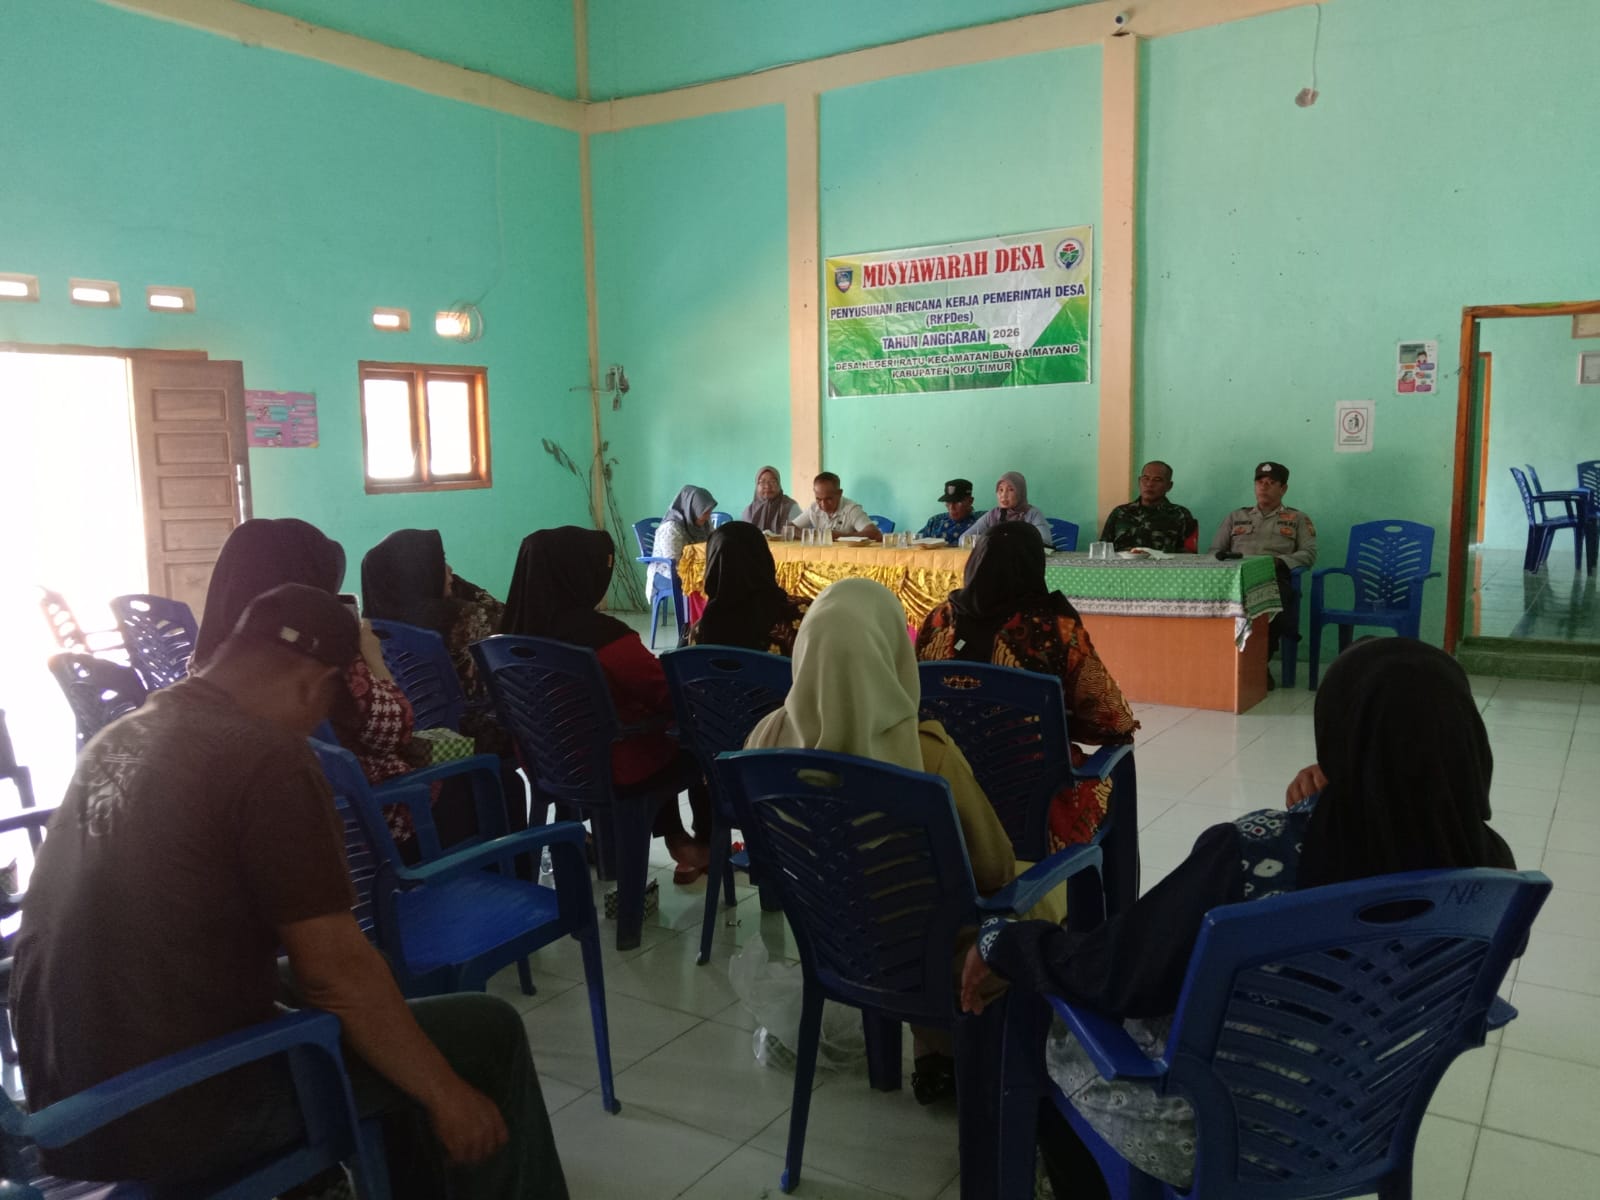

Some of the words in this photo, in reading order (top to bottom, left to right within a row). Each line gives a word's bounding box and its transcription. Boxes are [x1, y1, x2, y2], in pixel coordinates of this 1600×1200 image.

[862, 251, 989, 288] MUSYAWARAH
[994, 244, 1045, 274] DESA
[830, 303, 893, 320] PENYUSUNAN
[895, 298, 942, 313] RENCANA
[945, 295, 979, 309] KERJA
[983, 287, 1051, 305] PEMERINTAH
[1055, 284, 1085, 297] DESA
[926, 311, 974, 327] (RKPDes)
[882, 335, 918, 350] TAHUN
[922, 329, 986, 347] ANGGARAN
[993, 328, 1020, 339] 2026
[836, 362, 858, 371] DESA
[861, 360, 897, 369] NEGERI
[900, 357, 925, 366] RATU
[928, 353, 989, 364] KECAMATAN
[993, 348, 1029, 359] BUNGA
[1032, 345, 1079, 356] MAYANG
[892, 367, 950, 378] KABUPATEN
[953, 365, 975, 374] OKU
[978, 363, 1011, 372] TIMUR
